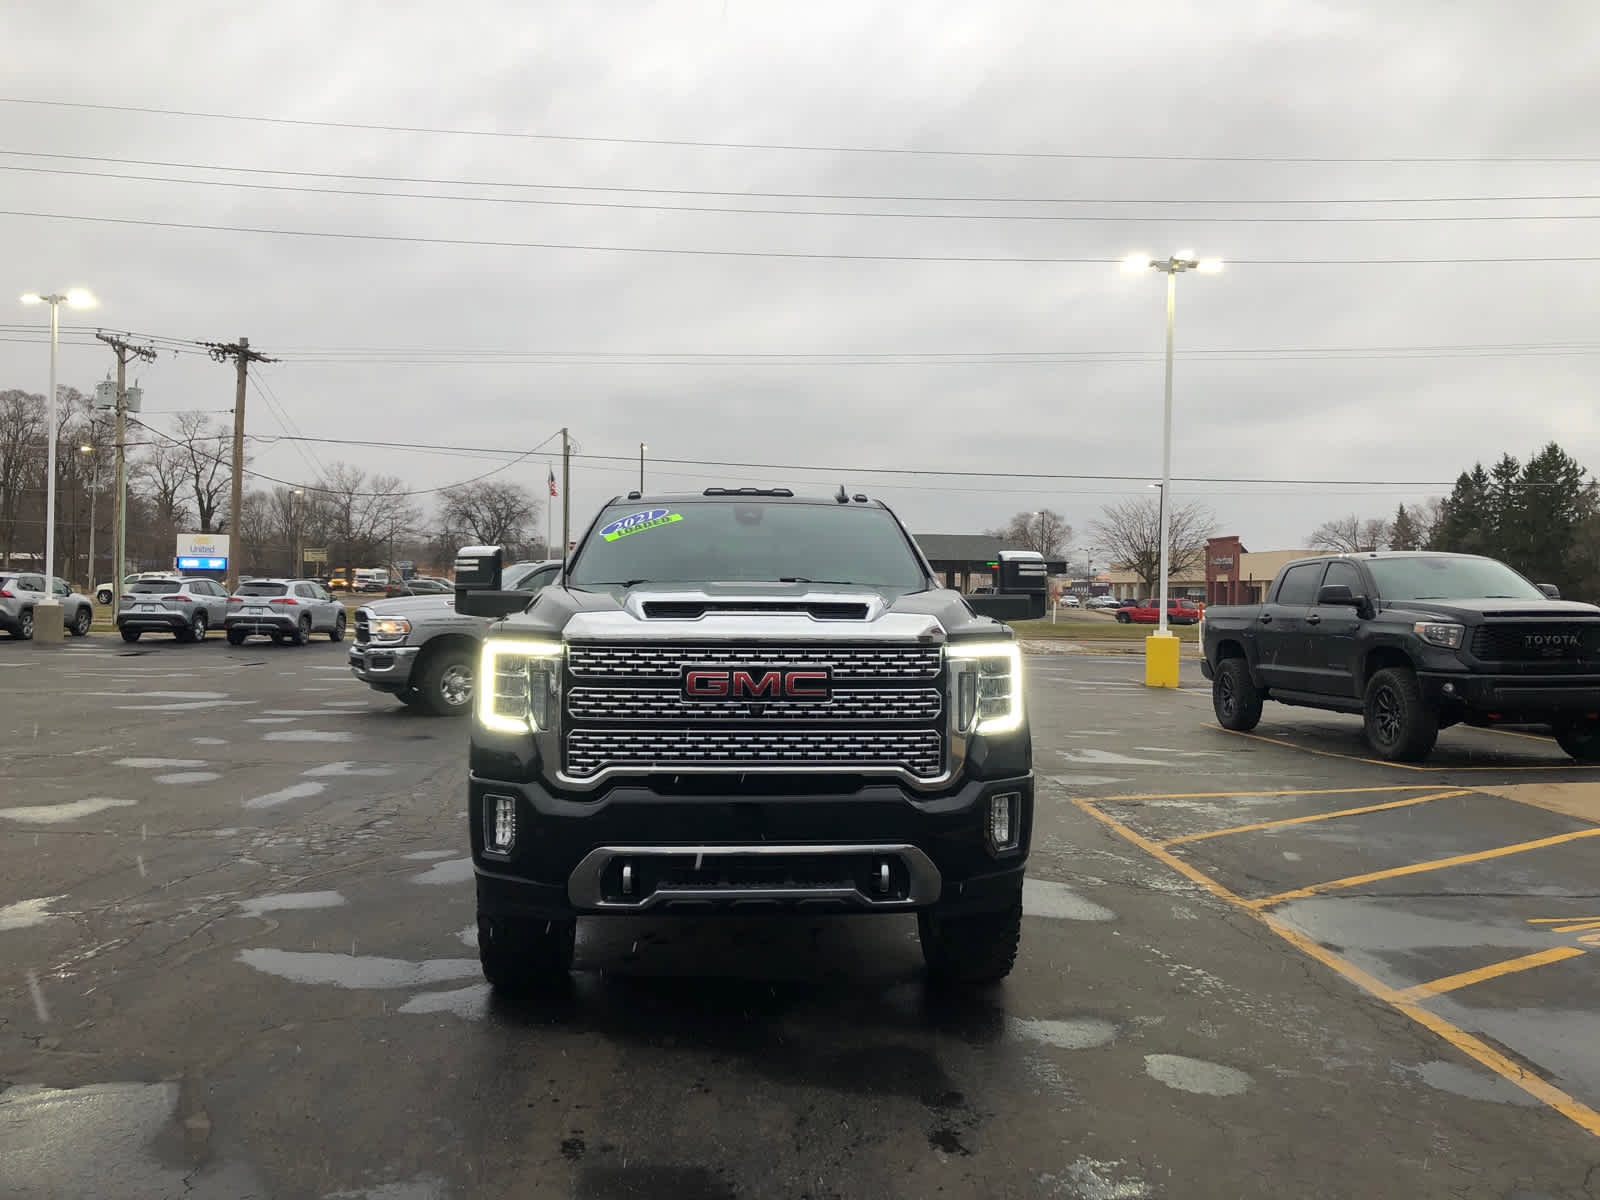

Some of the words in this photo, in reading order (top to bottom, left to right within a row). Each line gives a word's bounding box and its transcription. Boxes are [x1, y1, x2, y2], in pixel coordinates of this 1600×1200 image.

[614, 511, 653, 532] 2021
[616, 516, 673, 537] LOADED
[190, 544, 216, 553] United
[1525, 635, 1579, 645] TOYOTA
[686, 671, 827, 696] GMC
